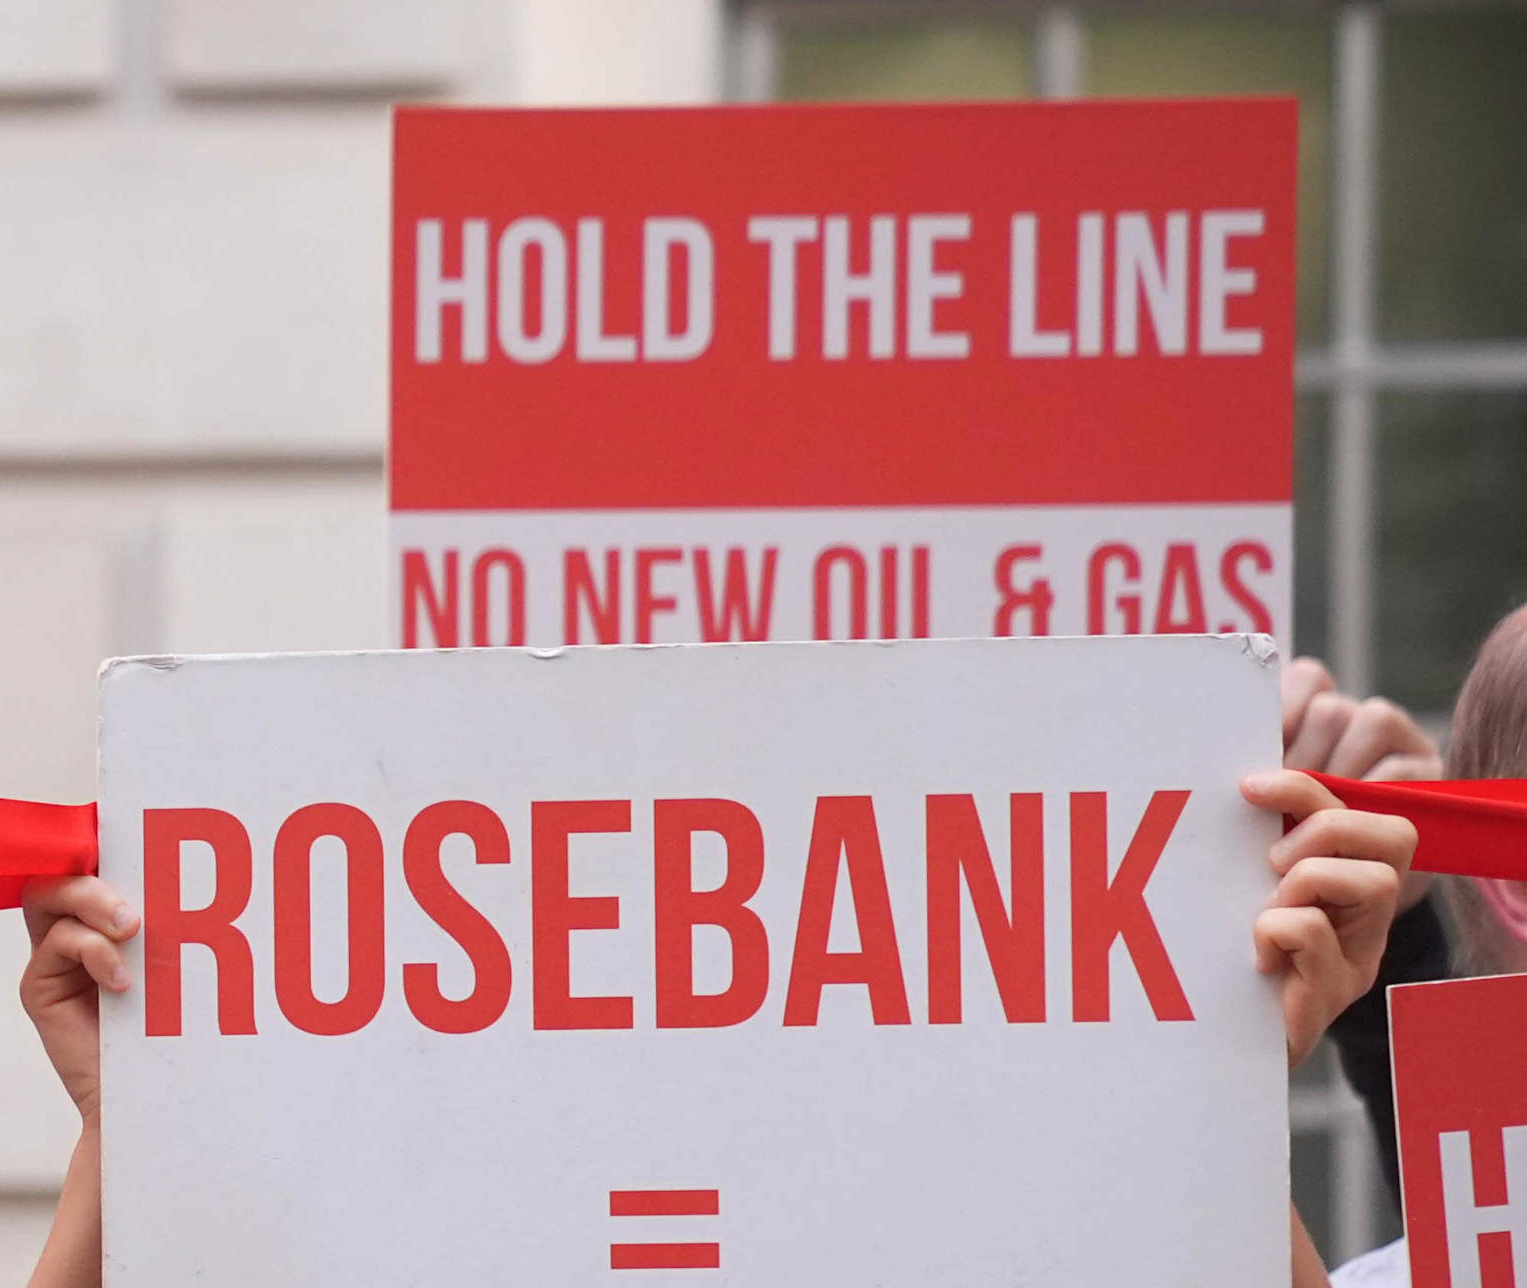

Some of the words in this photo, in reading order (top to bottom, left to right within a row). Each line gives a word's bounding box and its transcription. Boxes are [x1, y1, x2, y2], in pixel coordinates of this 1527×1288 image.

[415, 217, 714, 364] HOLD
[748, 214, 972, 361] THE
[1010, 210, 1265, 357] LINE
[402, 548, 526, 648] NO
[564, 547, 778, 645] NEW
[994, 544, 1055, 637] &
[1087, 541, 1274, 634] GAS
[142, 789, 1196, 1037] ROSEBANK
